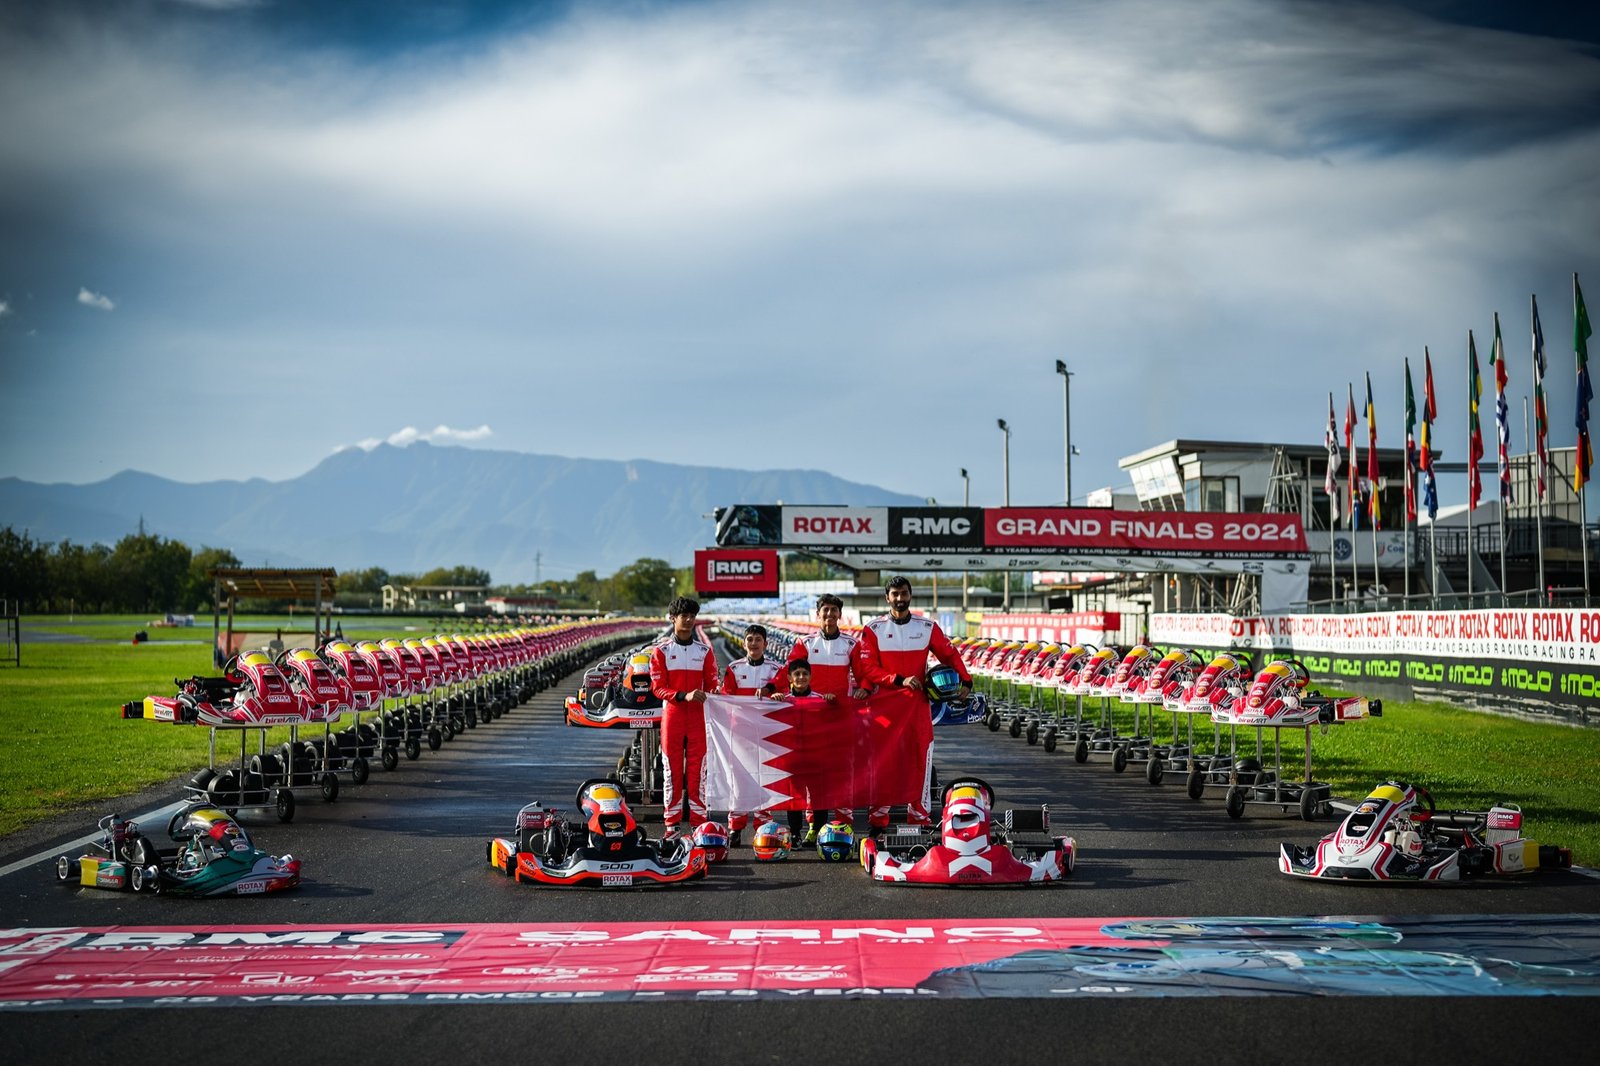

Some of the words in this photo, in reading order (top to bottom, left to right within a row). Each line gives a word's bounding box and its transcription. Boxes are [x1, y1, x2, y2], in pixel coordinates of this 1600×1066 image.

[793, 517, 873, 533] ROTAX
[902, 518, 971, 535] RMC
[996, 518, 1101, 536] GRAND
[1110, 520, 1214, 539] FINALS
[1223, 523, 1298, 540] 2024
[716, 562, 762, 574] RMC
[1344, 618, 1364, 638] ROTAX
[1367, 616, 1392, 638] ROTAX
[1396, 614, 1423, 638] ROTAX
[1427, 614, 1456, 639] ROTAX
[1460, 613, 1490, 640] ROTAX
[1494, 612, 1528, 640] ROTAX
[1532, 612, 1574, 642] ROTAX
[1494, 643, 1529, 656] RACING
[1534, 645, 1575, 660] RACING
[86, 931, 445, 945] RMC
[516, 926, 1042, 942] SARNO
[240, 994, 409, 1002] YEARS
[426, 992, 604, 1000] RMCGF
